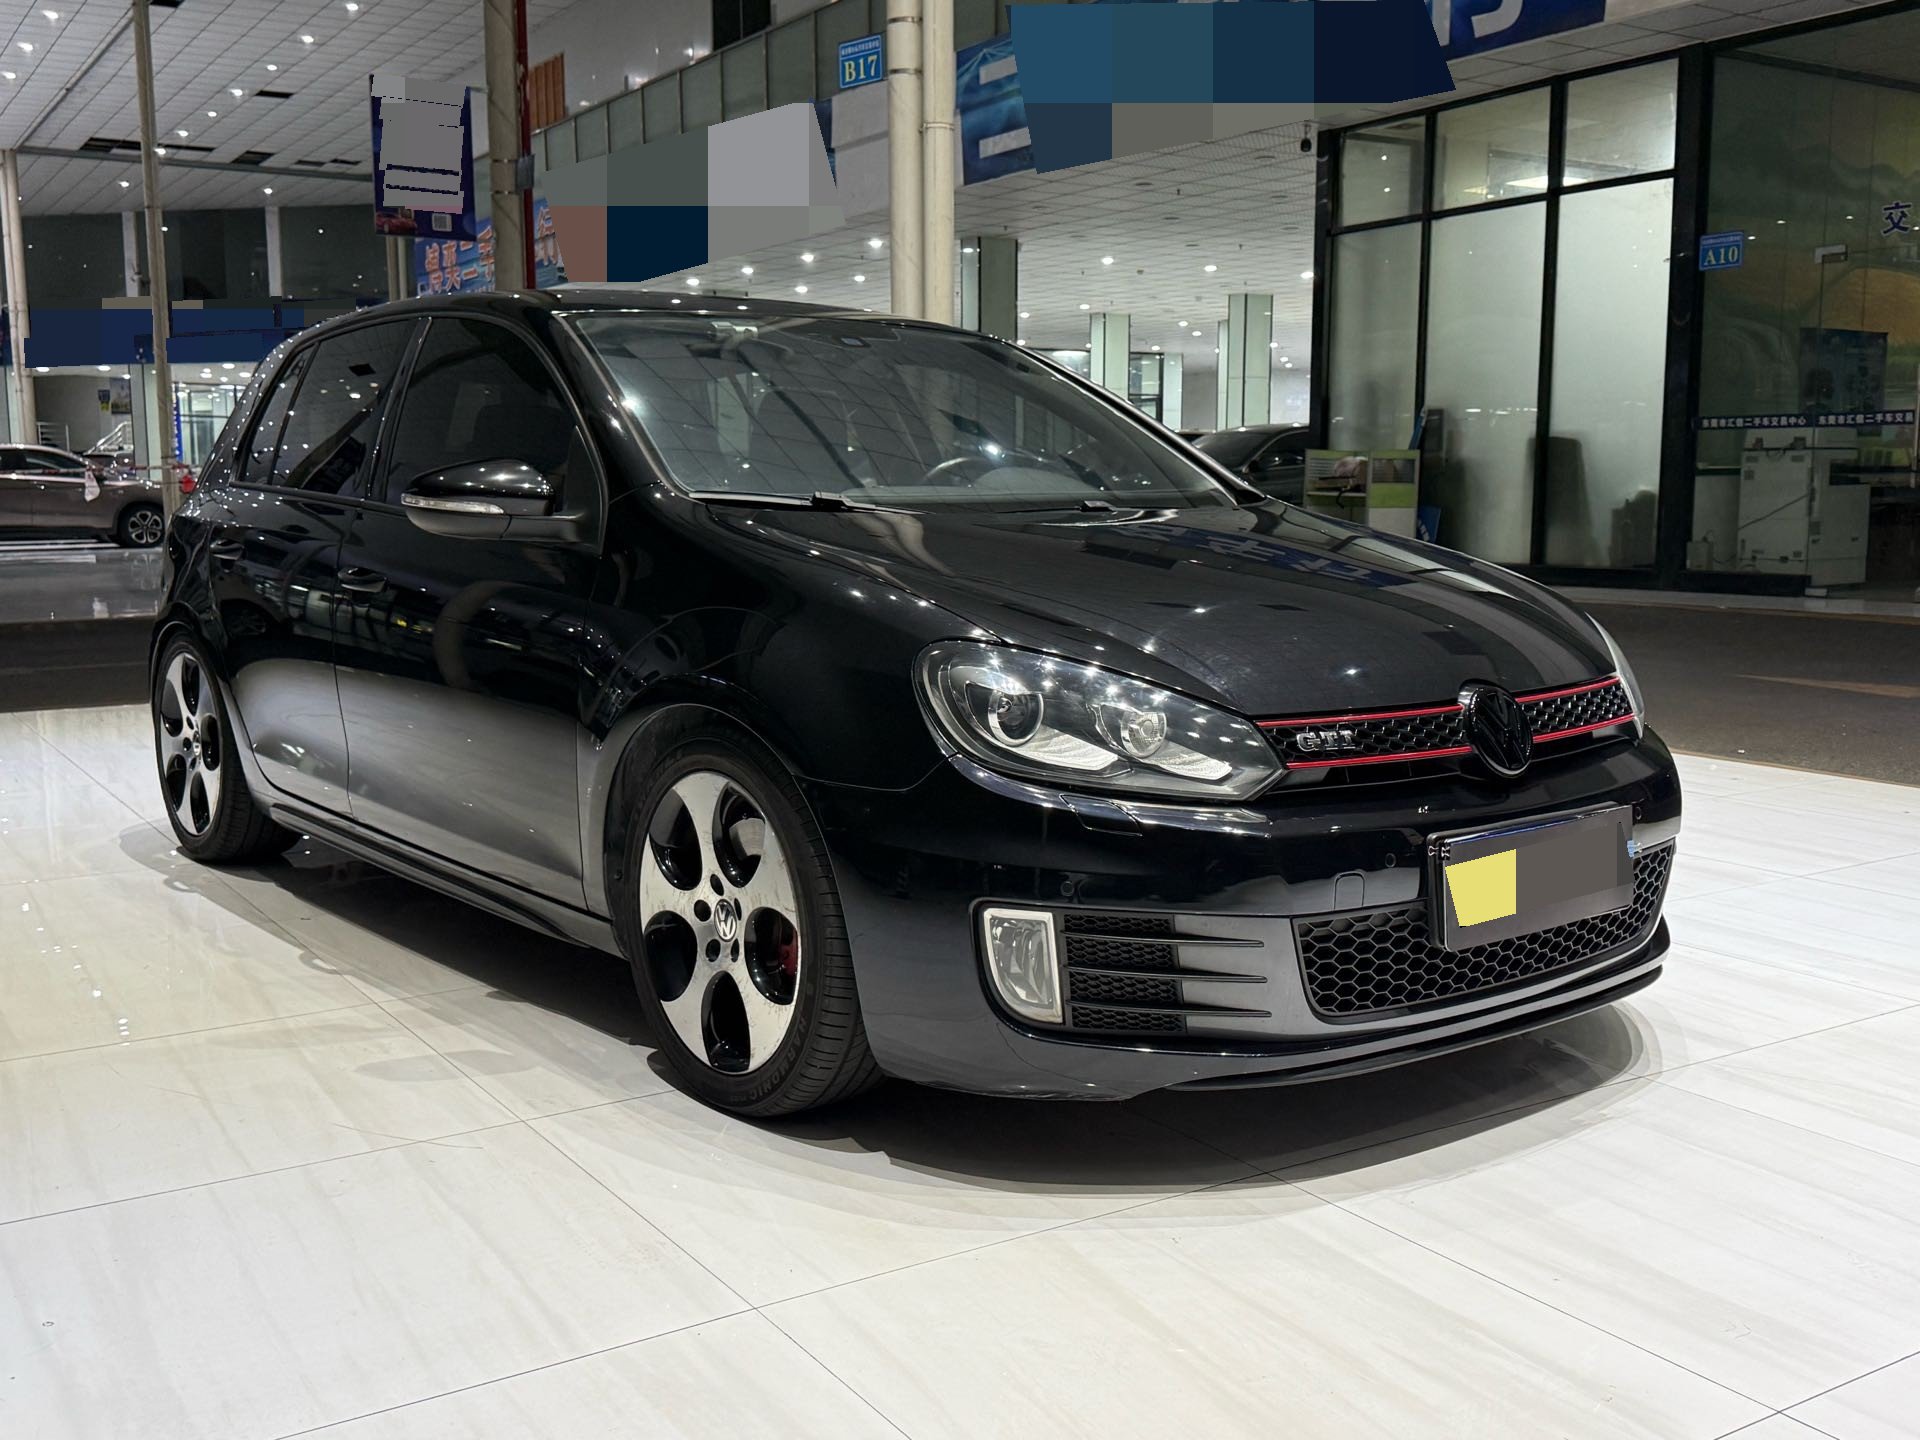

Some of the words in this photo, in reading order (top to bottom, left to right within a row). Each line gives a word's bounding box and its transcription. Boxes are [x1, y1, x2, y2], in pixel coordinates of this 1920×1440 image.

[843, 55, 878, 83] B17
[1882, 201, 1912, 237] 交
[1703, 246, 1738, 266] A10
[1296, 730, 1356, 752] GTI
